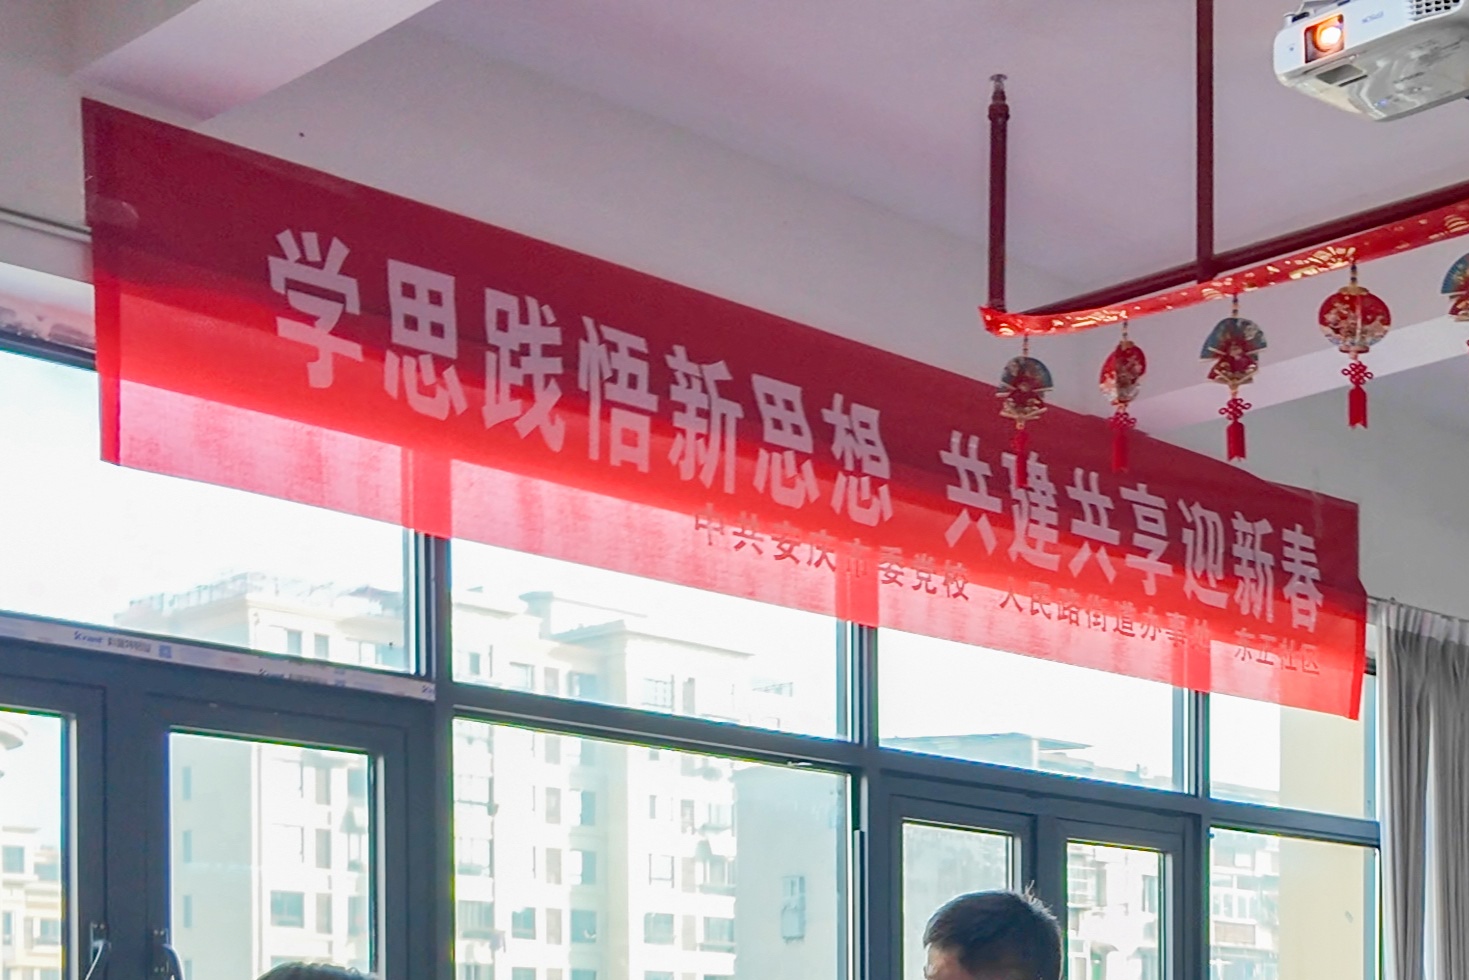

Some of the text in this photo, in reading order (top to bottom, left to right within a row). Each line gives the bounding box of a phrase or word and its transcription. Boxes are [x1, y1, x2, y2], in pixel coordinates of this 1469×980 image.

[267, 228, 1323, 633] 学思践悟新思想 共建共享迎新春
